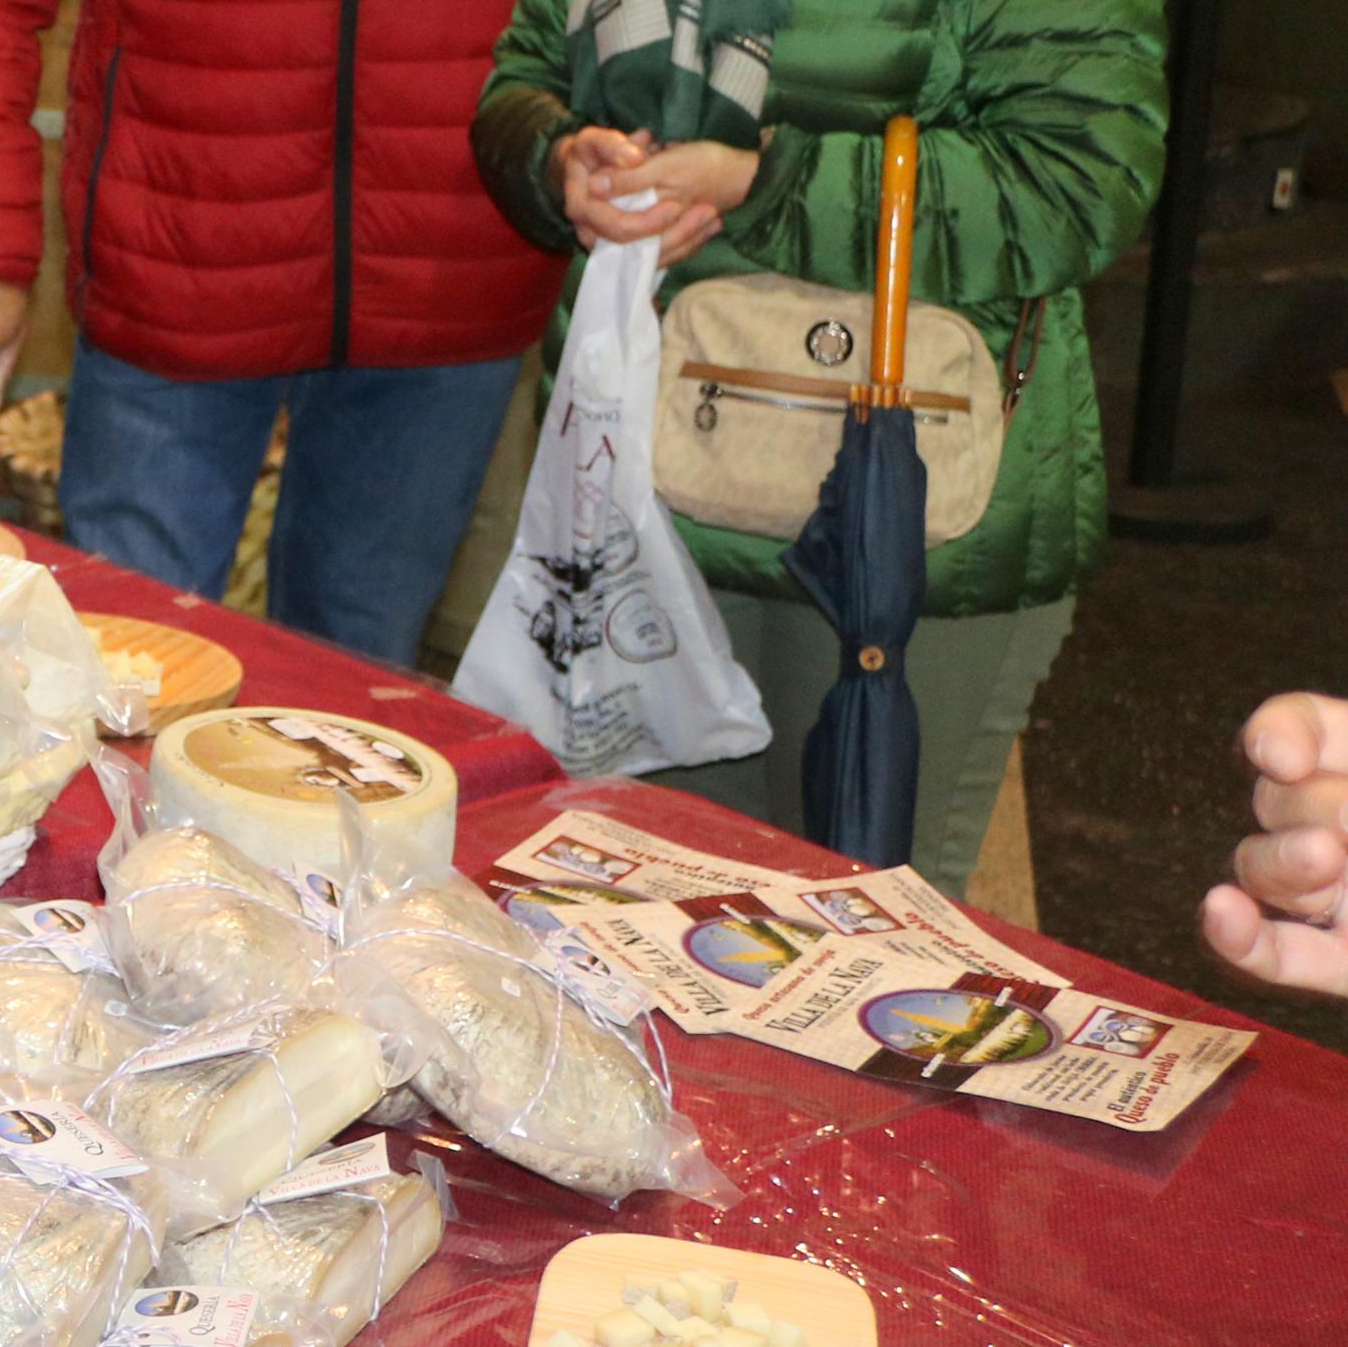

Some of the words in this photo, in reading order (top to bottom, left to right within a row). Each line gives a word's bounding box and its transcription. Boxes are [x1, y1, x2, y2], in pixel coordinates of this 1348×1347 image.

[764, 1002, 827, 1035] VILLA
[808, 992, 841, 1010] DE
[828, 957, 884, 985] NAVA
[1151, 1052, 1180, 1086] pueblo
[1145, 1081, 1161, 1096] de
[1114, 1094, 1154, 1124] Queso
[344, 1164, 381, 1178] NAVA
